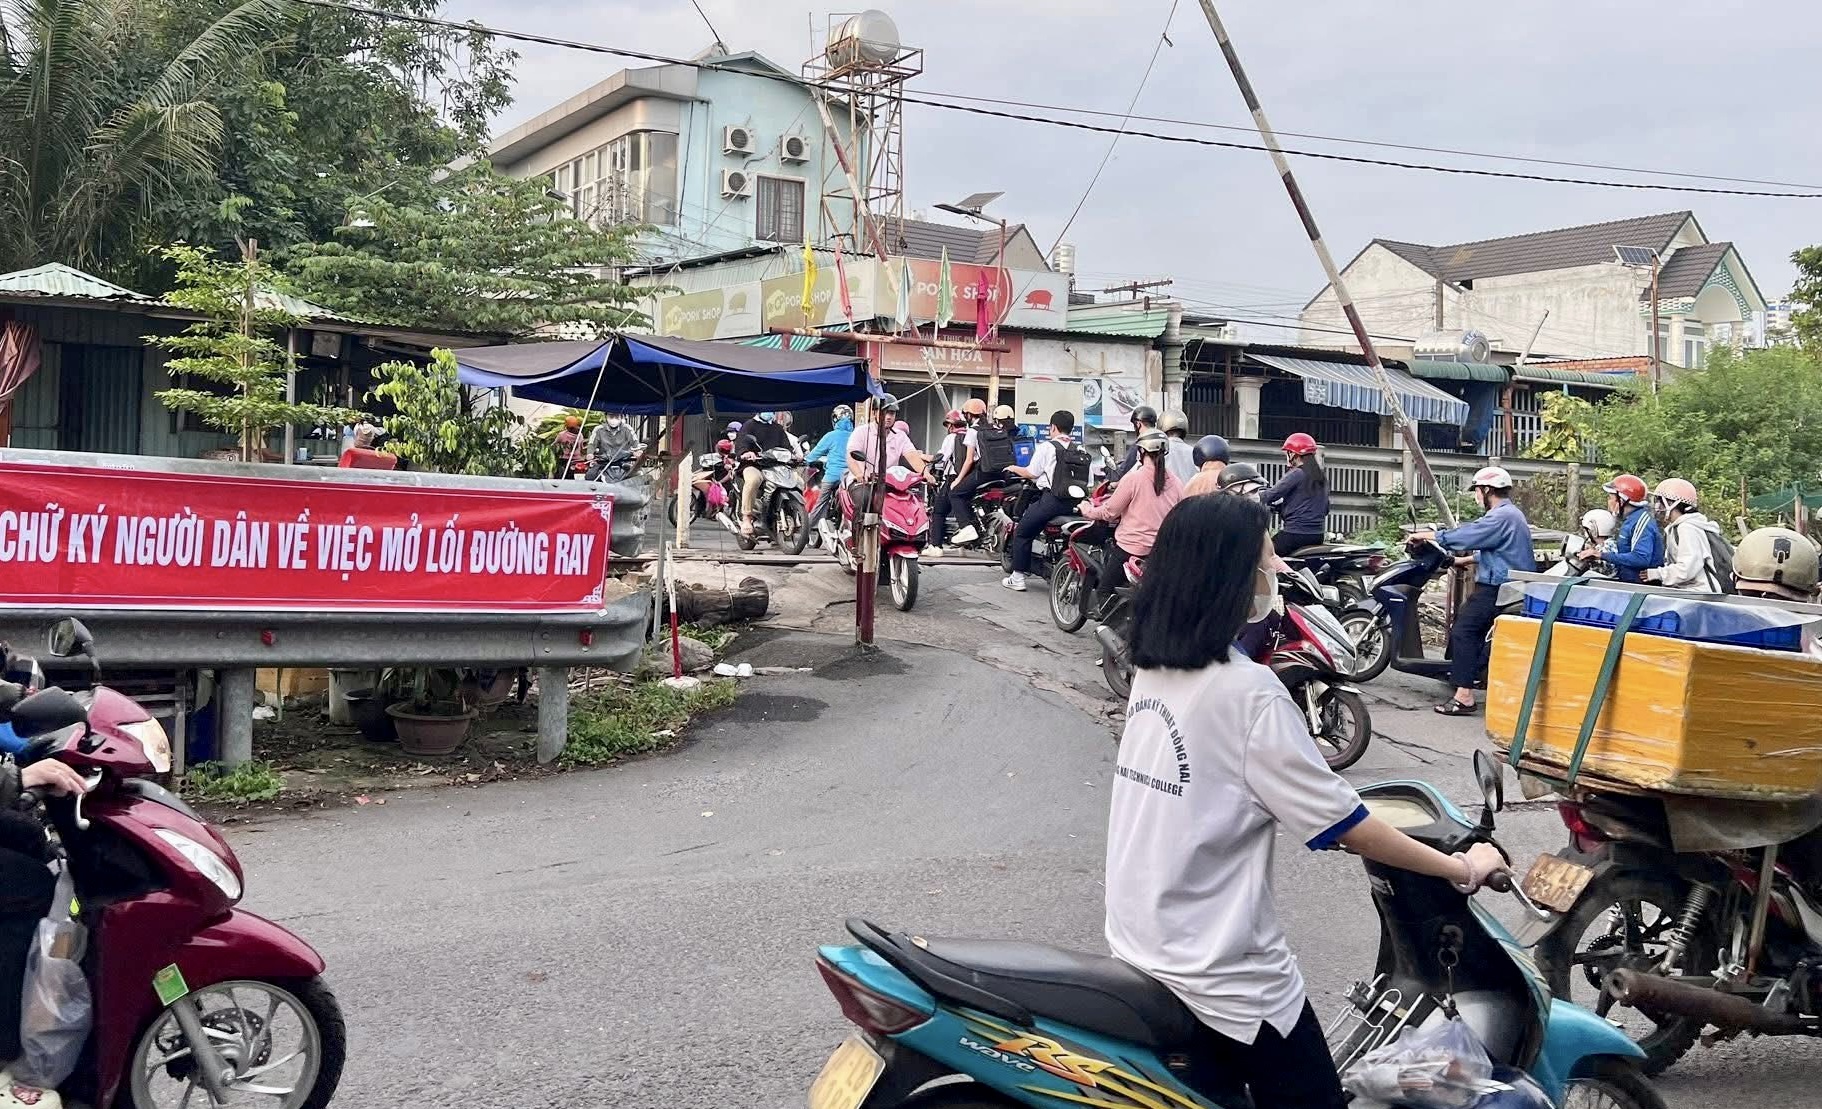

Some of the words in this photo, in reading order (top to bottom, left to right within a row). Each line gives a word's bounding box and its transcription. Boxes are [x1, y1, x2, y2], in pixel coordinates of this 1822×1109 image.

[917, 282, 957, 298] POK
[785, 294, 802, 307] POR
[680, 309, 700, 322] PORK
[702, 307, 721, 320] SHOP
[0, 503, 64, 562] CHỮ
[67, 504, 109, 563] KÝ
[114, 506, 204, 567] NGƯỜI
[211, 511, 270, 569] DÂN
[278, 508, 310, 570] VỀ
[318, 516, 374, 581] VIỆC
[379, 513, 422, 573] MỞ
[426, 514, 466, 573] LỐI
[470, 521, 549, 575] ĐƯỜNG
[554, 533, 595, 575] RAY
[1178, 763, 1191, 783] NAI
[1151, 778, 1183, 797] COLLEGE
